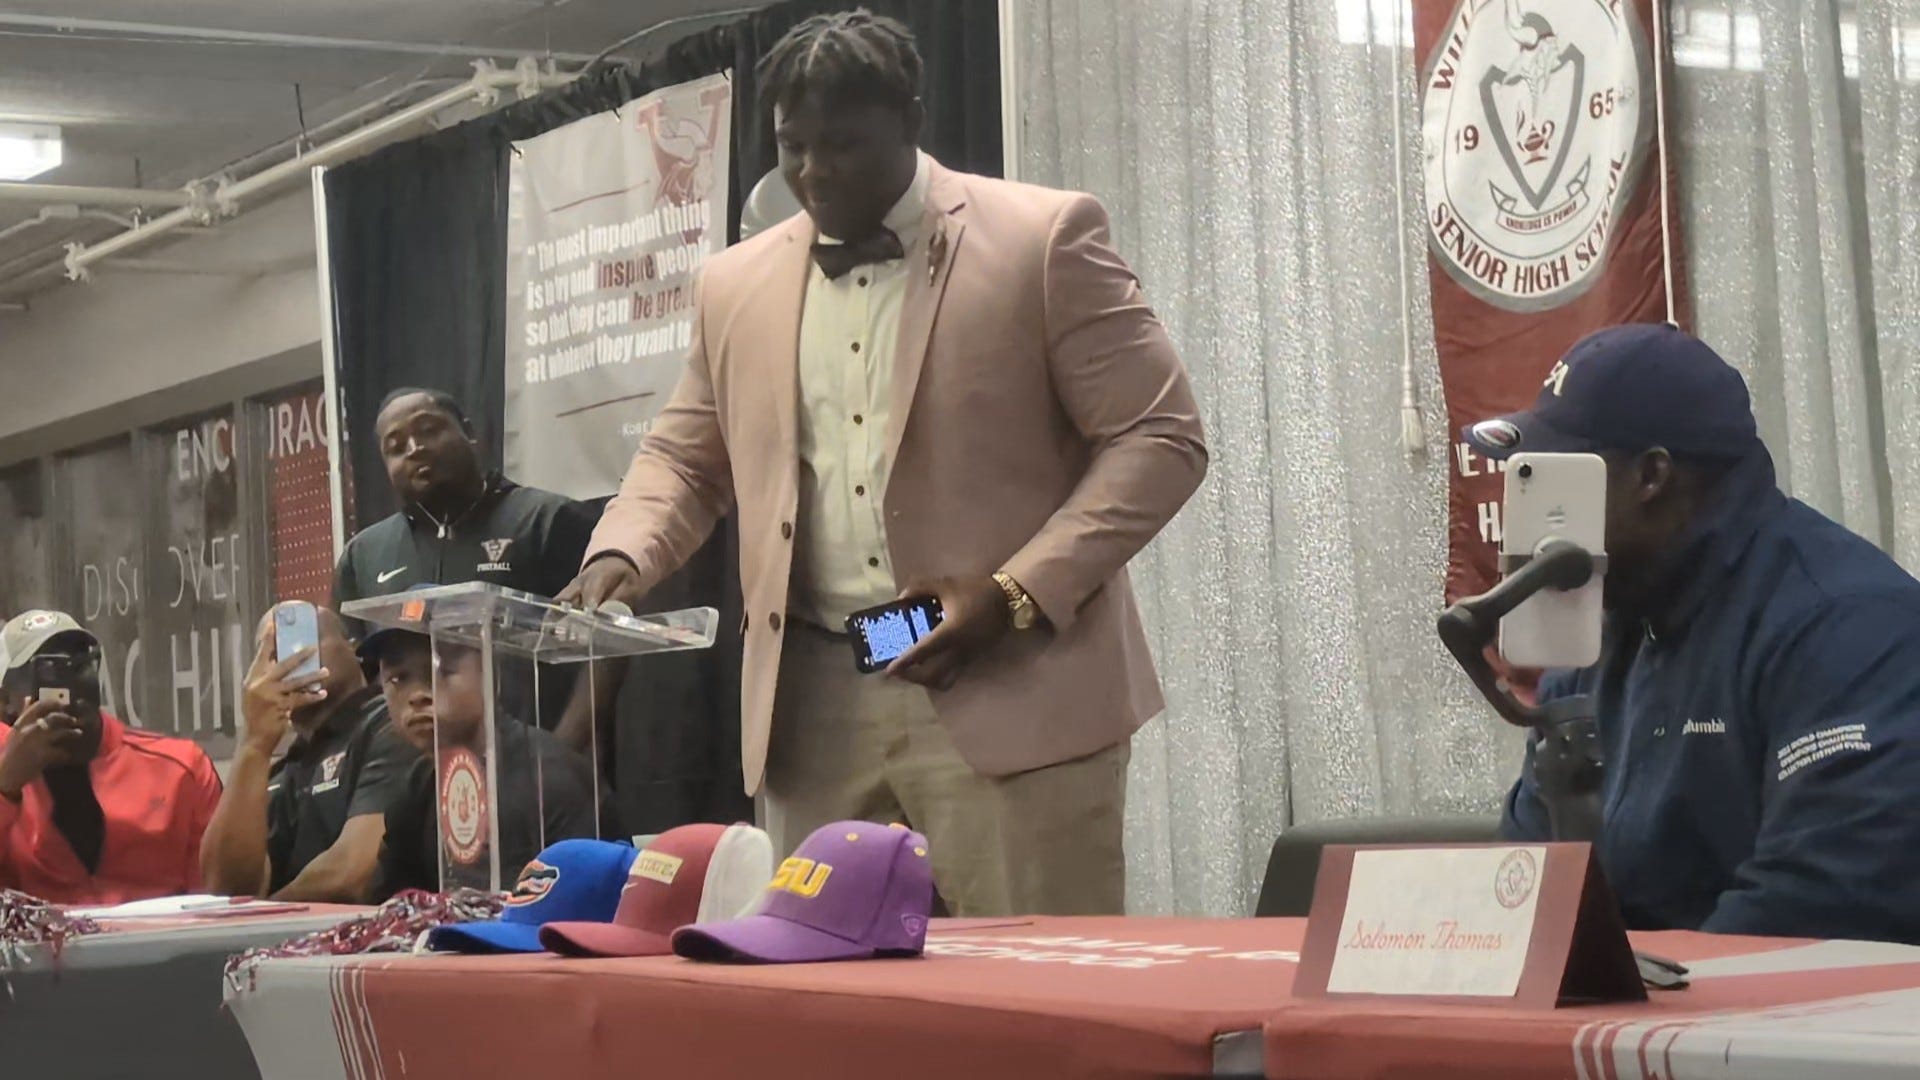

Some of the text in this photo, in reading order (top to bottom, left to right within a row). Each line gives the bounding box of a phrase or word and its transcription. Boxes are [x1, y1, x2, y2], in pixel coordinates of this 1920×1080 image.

[1589, 87, 1614, 120] 65
[1454, 124, 1480, 154] 19
[662, 199, 711, 241] thing
[1431, 202, 1508, 289] SENIOR
[1513, 256, 1570, 294] HIGH
[526, 281, 544, 312] is
[597, 253, 656, 290] inspire
[525, 320, 549, 347] so
[596, 297, 630, 328] can
[632, 291, 653, 321] be
[655, 280, 697, 319] gret
[525, 353, 547, 384] at
[596, 333, 634, 365] they
[634, 322, 675, 358] want
[1343, 918, 1503, 951] Solomon Thomas
